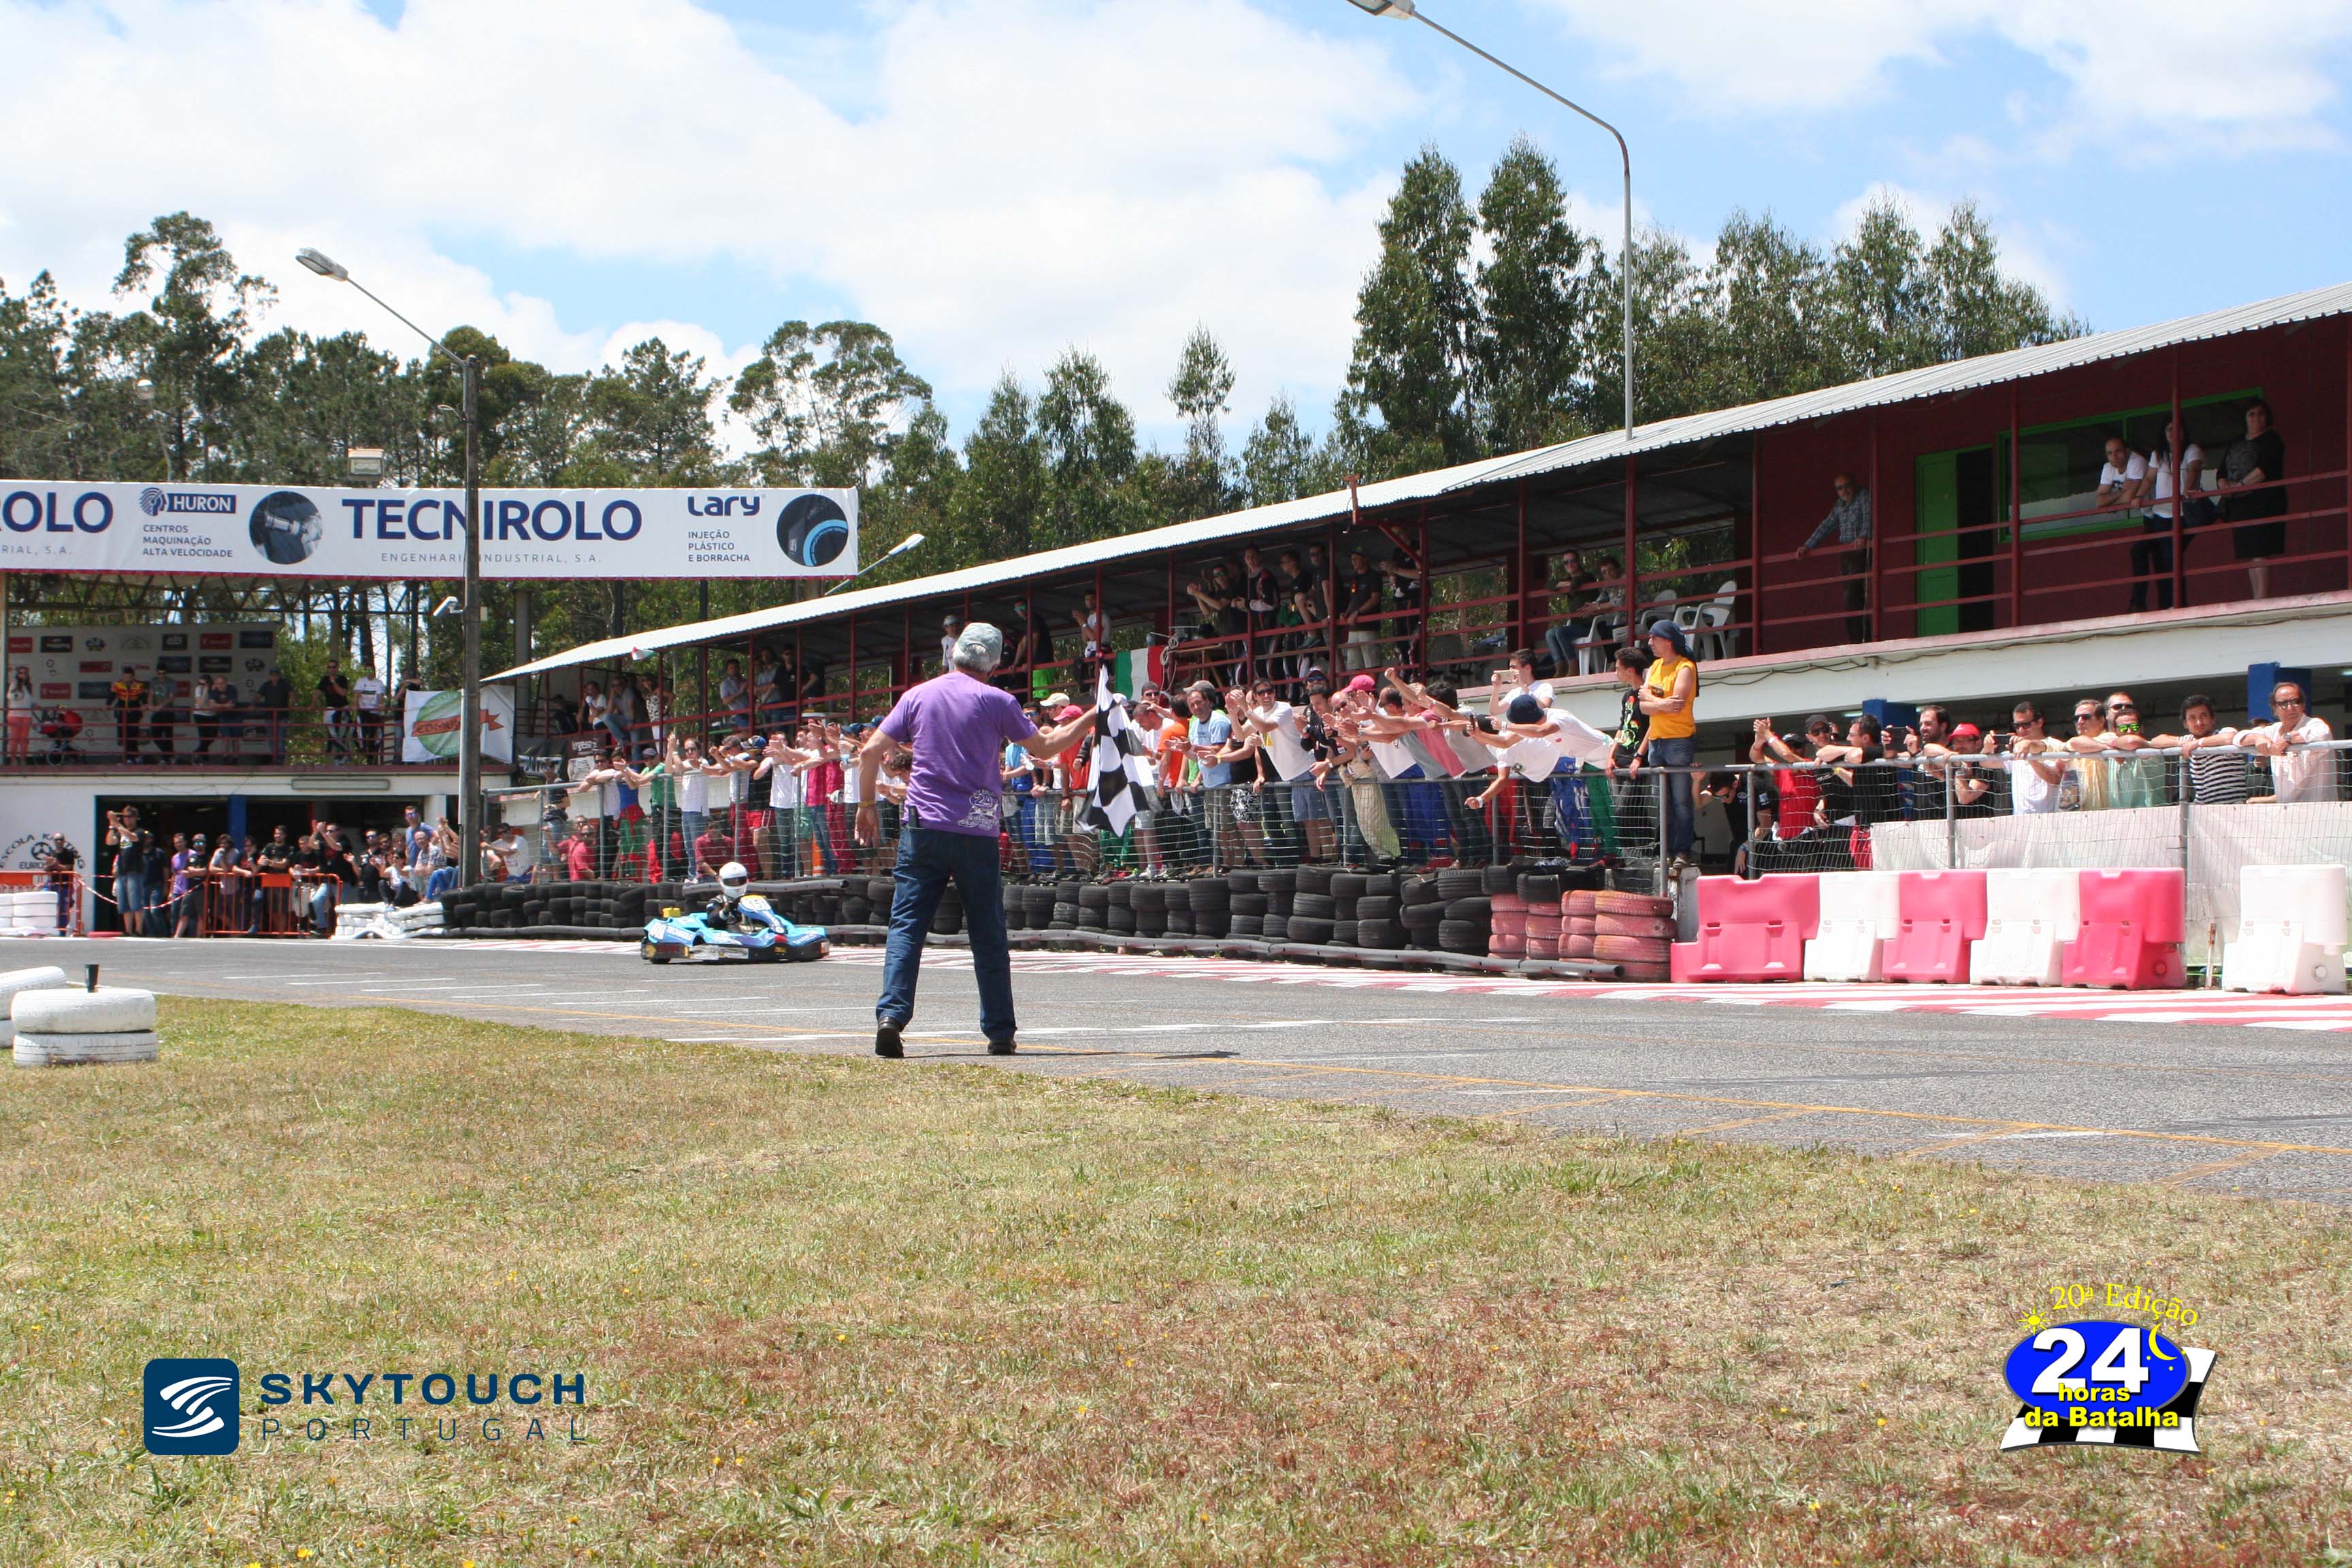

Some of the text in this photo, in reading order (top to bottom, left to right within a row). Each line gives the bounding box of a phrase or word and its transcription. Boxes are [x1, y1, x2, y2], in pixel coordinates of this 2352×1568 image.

[174, 495, 231, 511] HURON
[0, 491, 114, 534] OLO
[342, 498, 642, 541] TECNIROLO
[143, 524, 189, 533] CENTROS
[688, 529, 730, 540] INJEÇÃO
[143, 536, 212, 546] MAQUINAÇÃO
[688, 541, 735, 550] PLÁSTICO
[45, 546, 71, 555] S.A.
[170, 549, 233, 557] VELOCIDADE
[575, 554, 602, 562] S.A.
